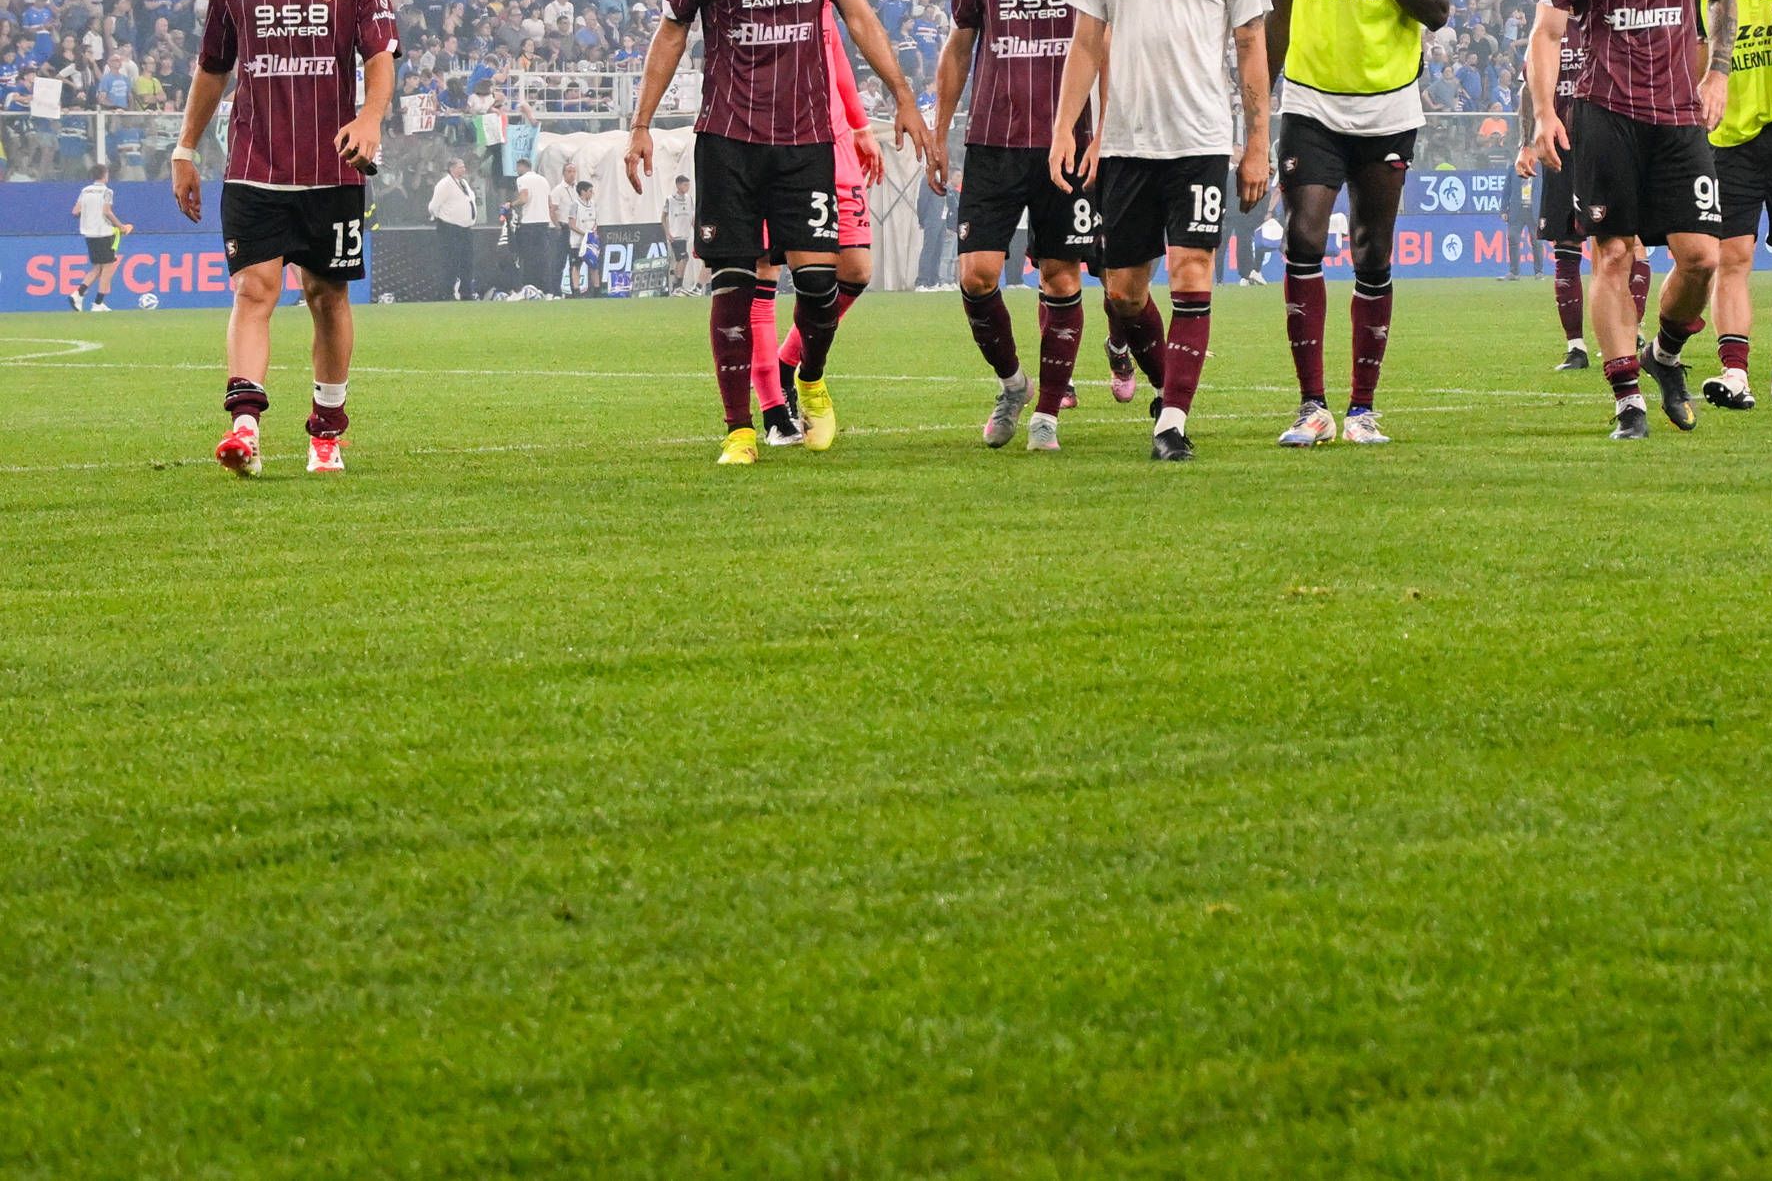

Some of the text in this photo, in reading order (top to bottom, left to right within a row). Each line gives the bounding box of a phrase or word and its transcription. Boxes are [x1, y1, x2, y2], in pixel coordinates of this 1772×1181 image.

[1000, 8, 1067, 20] SANTERO
[257, 26, 329, 38] SANTERO
[1190, 184, 1222, 224] 18
[1187, 222, 1219, 233] Zeus
[332, 219, 362, 257] 13
[1065, 234, 1094, 245] Zeus
[329, 257, 362, 268] Zeus
